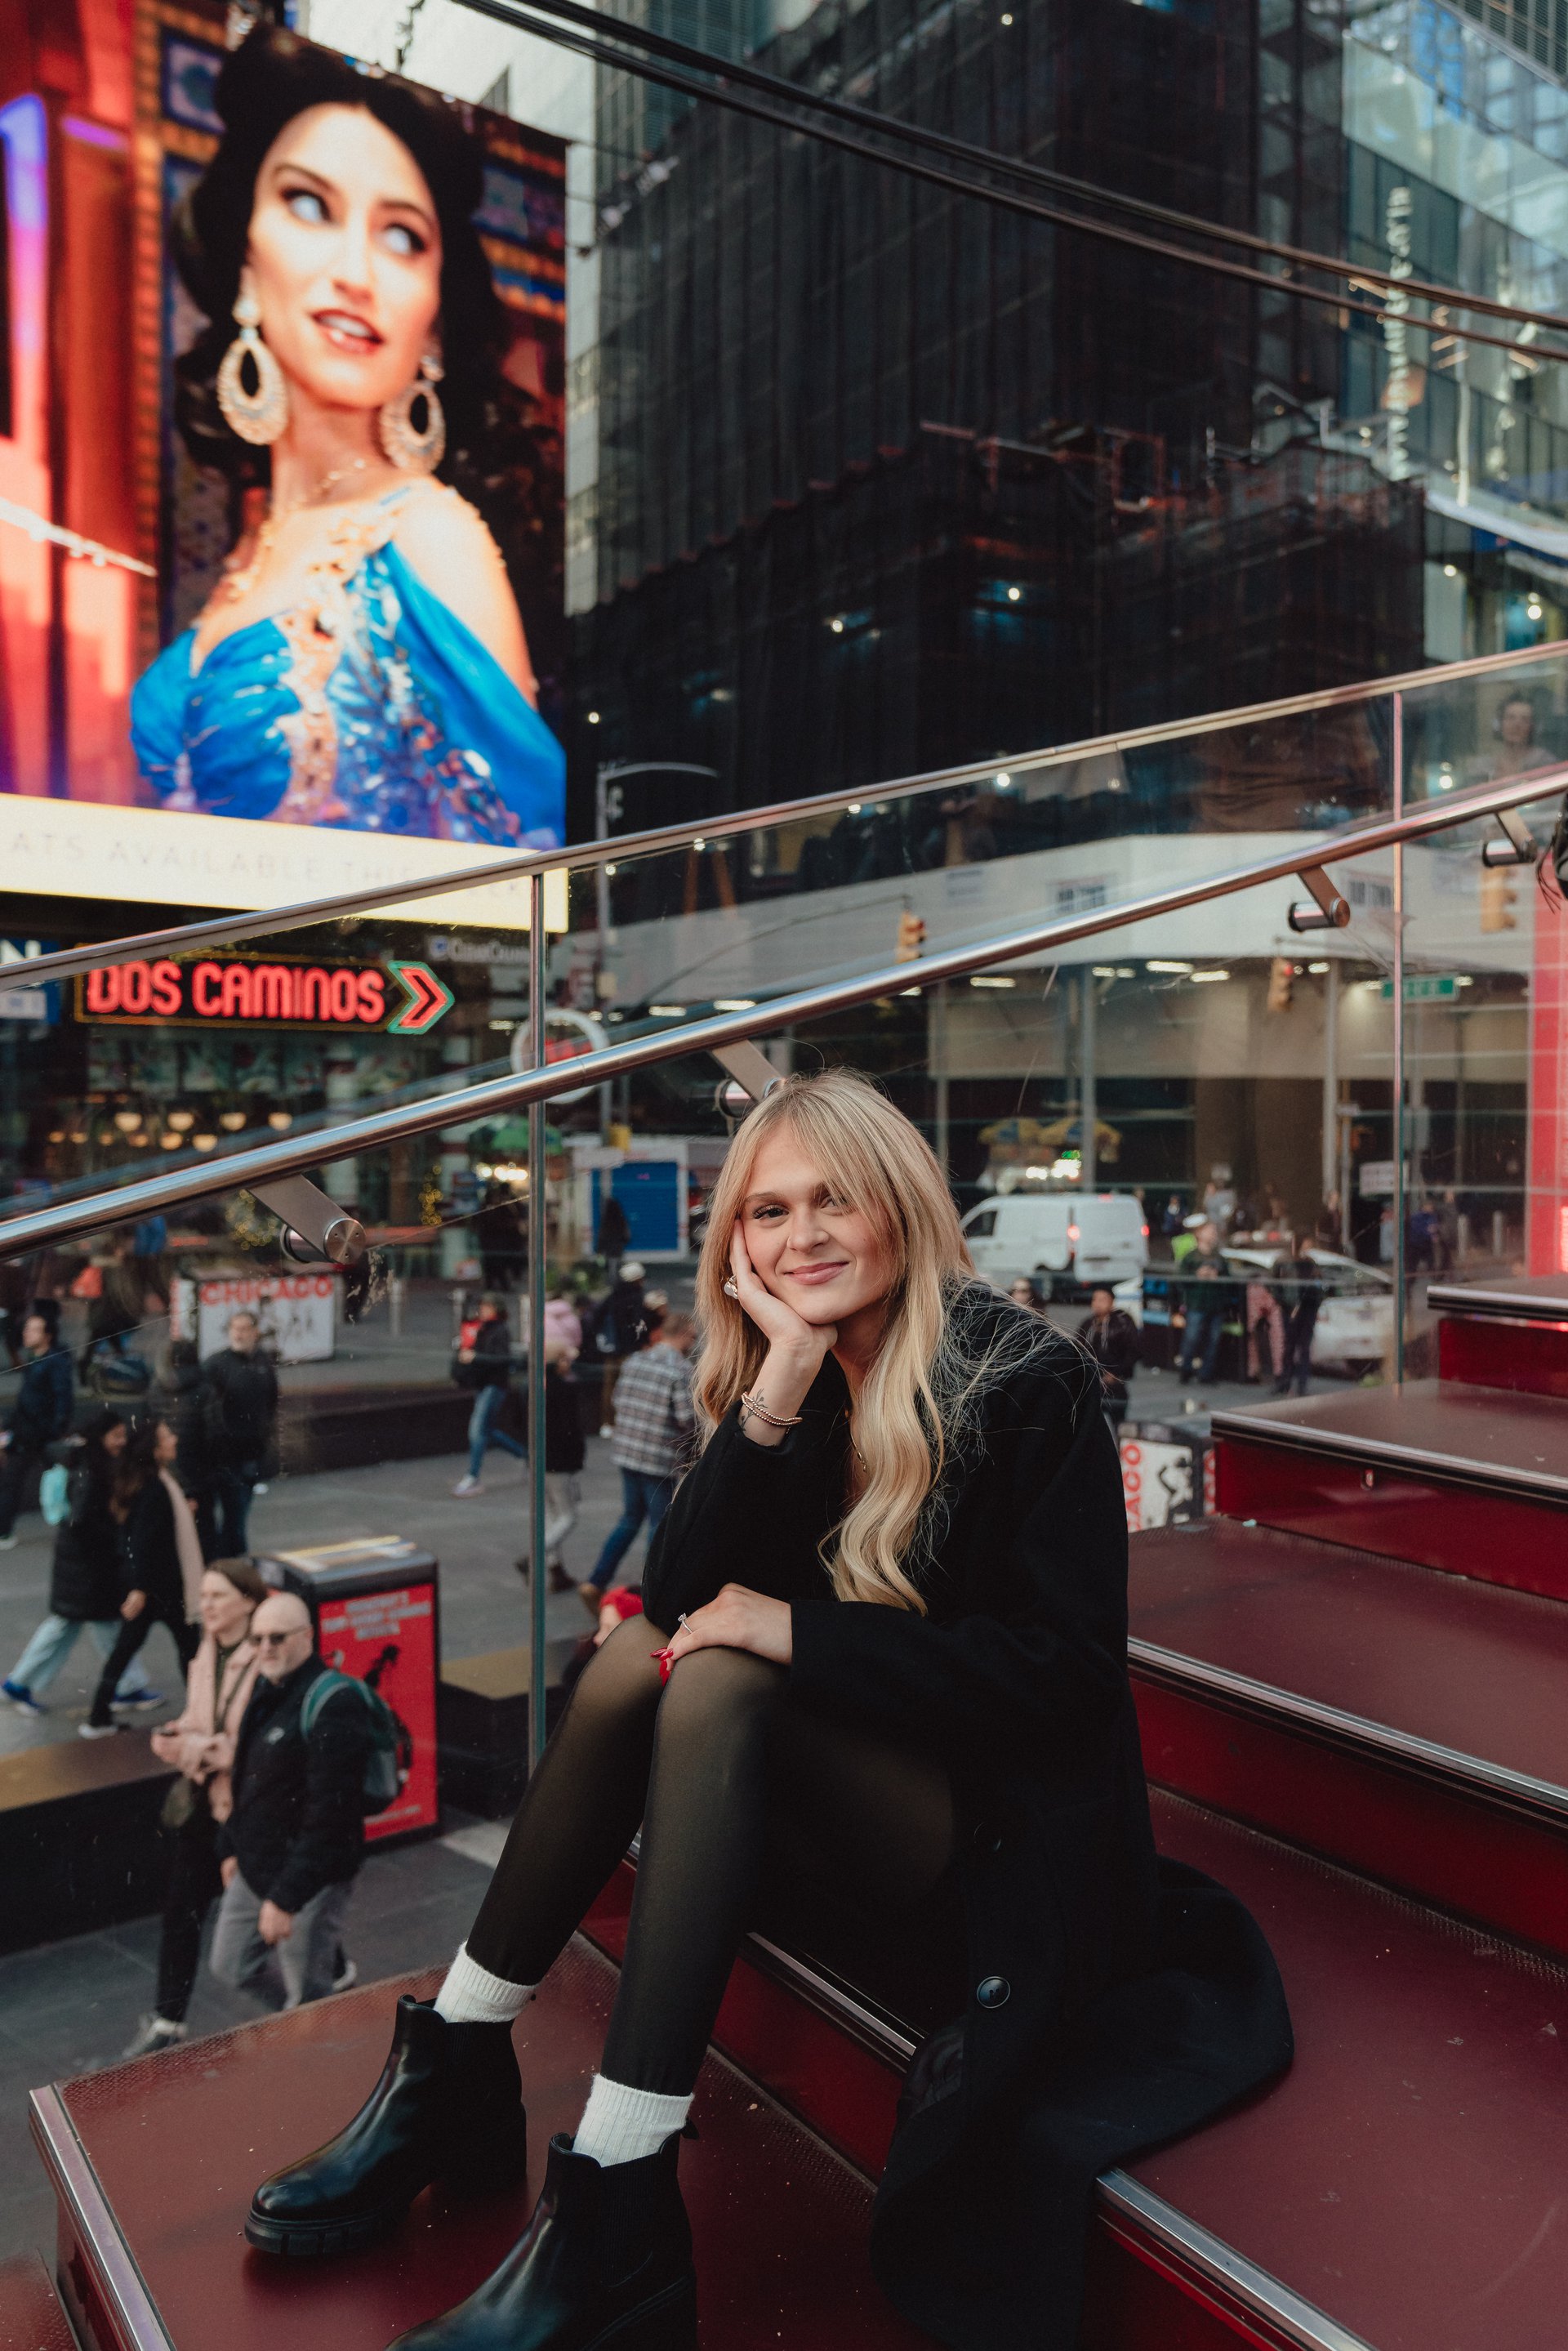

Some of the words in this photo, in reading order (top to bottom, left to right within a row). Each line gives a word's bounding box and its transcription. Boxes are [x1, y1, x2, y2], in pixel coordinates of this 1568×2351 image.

[106, 840, 322, 884] AVAILABLE
[87, 960, 182, 1015] DOS
[192, 961, 385, 1023] CAMINOS
